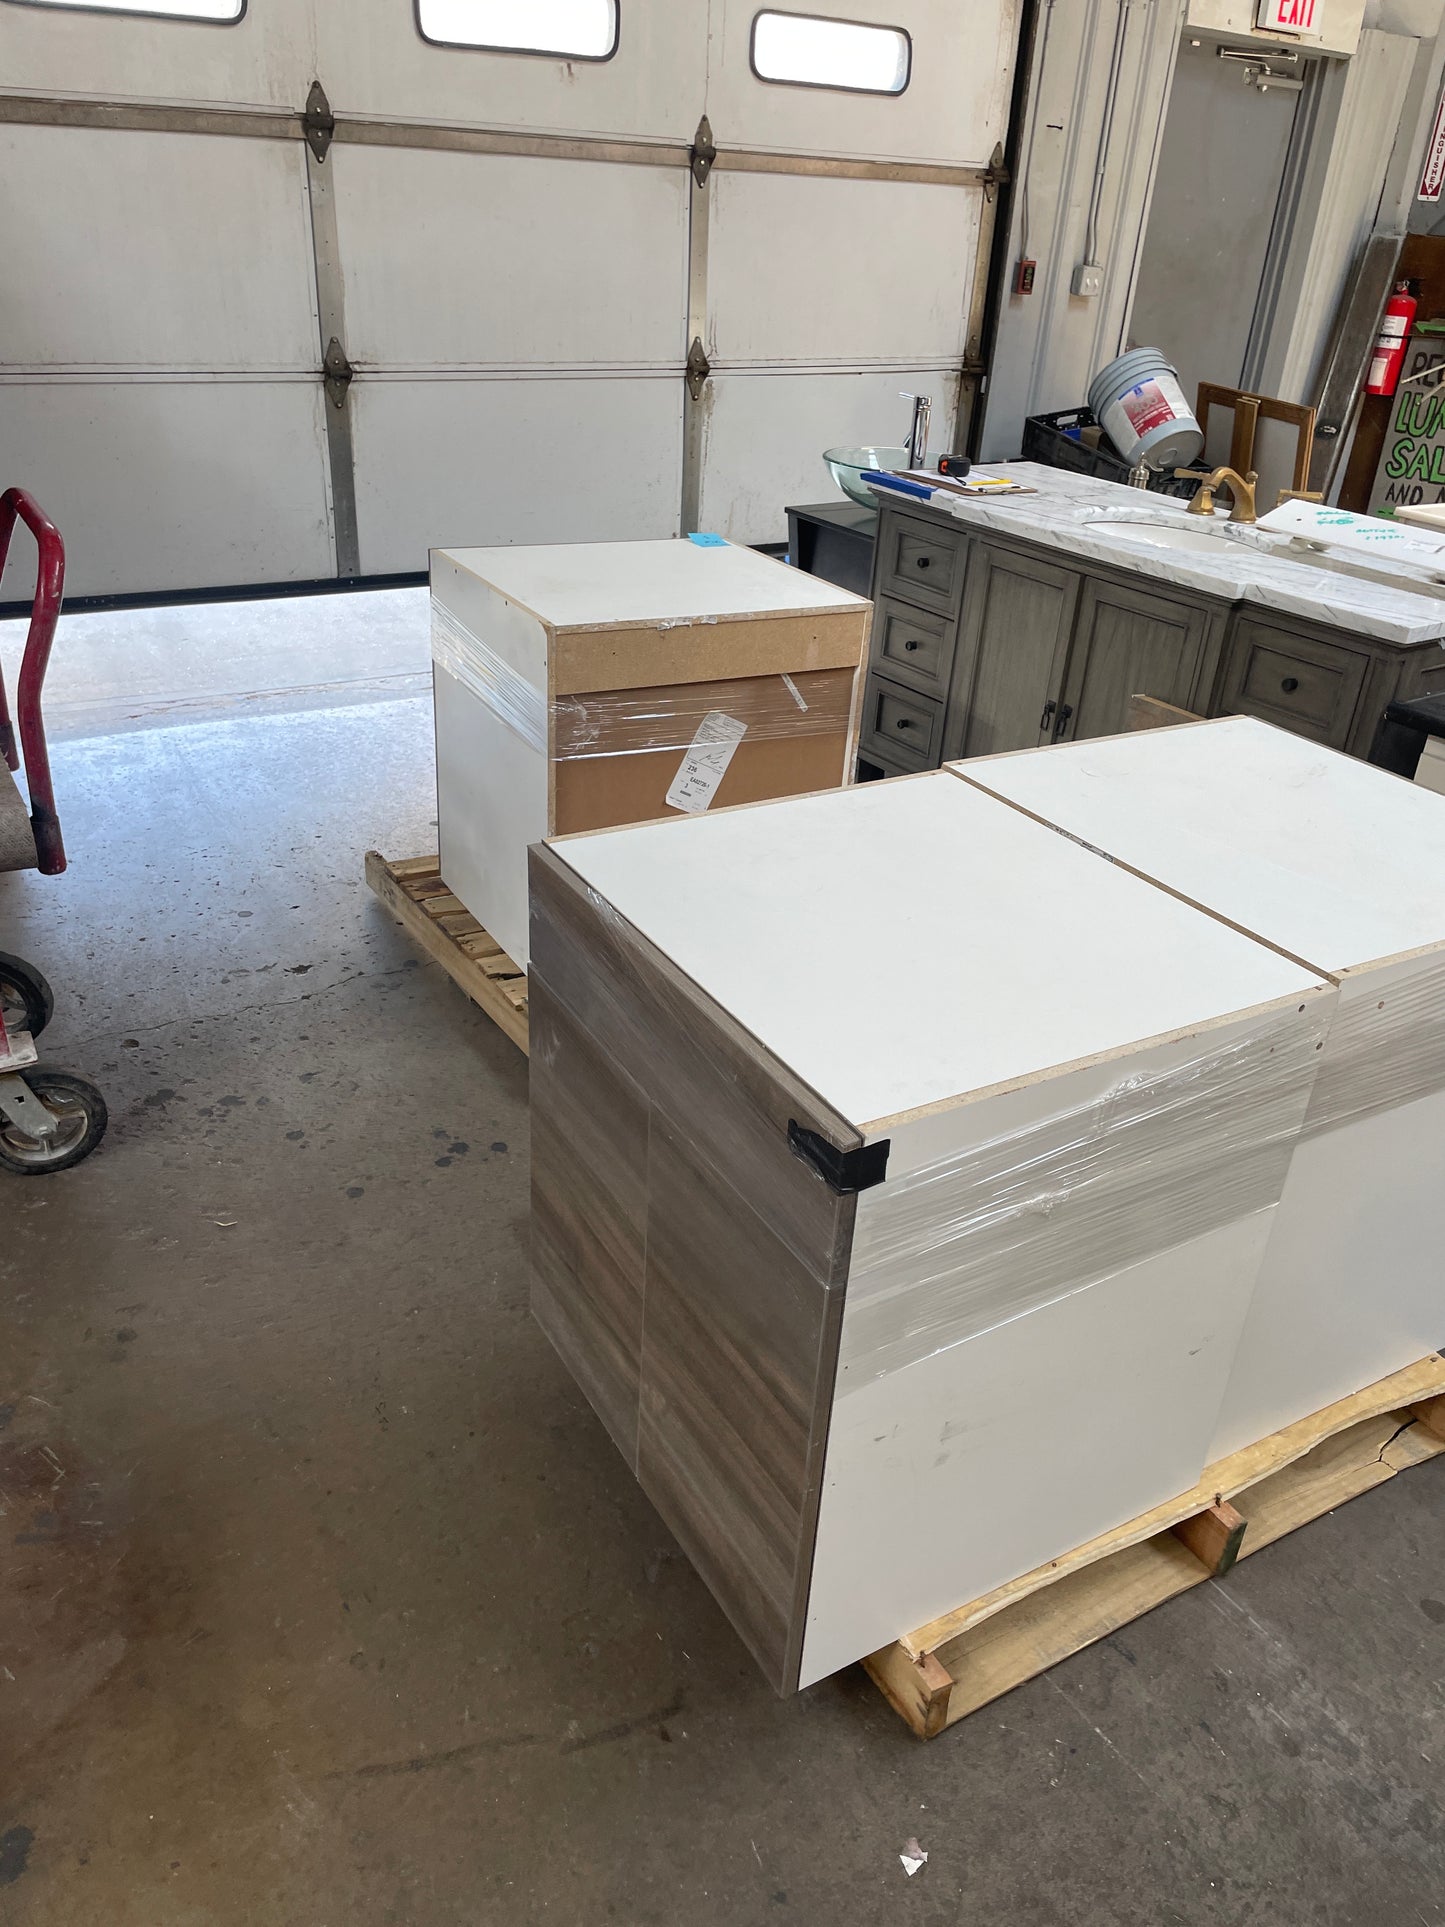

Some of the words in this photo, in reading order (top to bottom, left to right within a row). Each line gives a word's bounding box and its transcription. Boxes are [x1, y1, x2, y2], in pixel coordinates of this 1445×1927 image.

[1408, 352, 1445, 387] RE
[1385, 438, 1445, 485] SAL
[1385, 482, 1424, 505] AND
